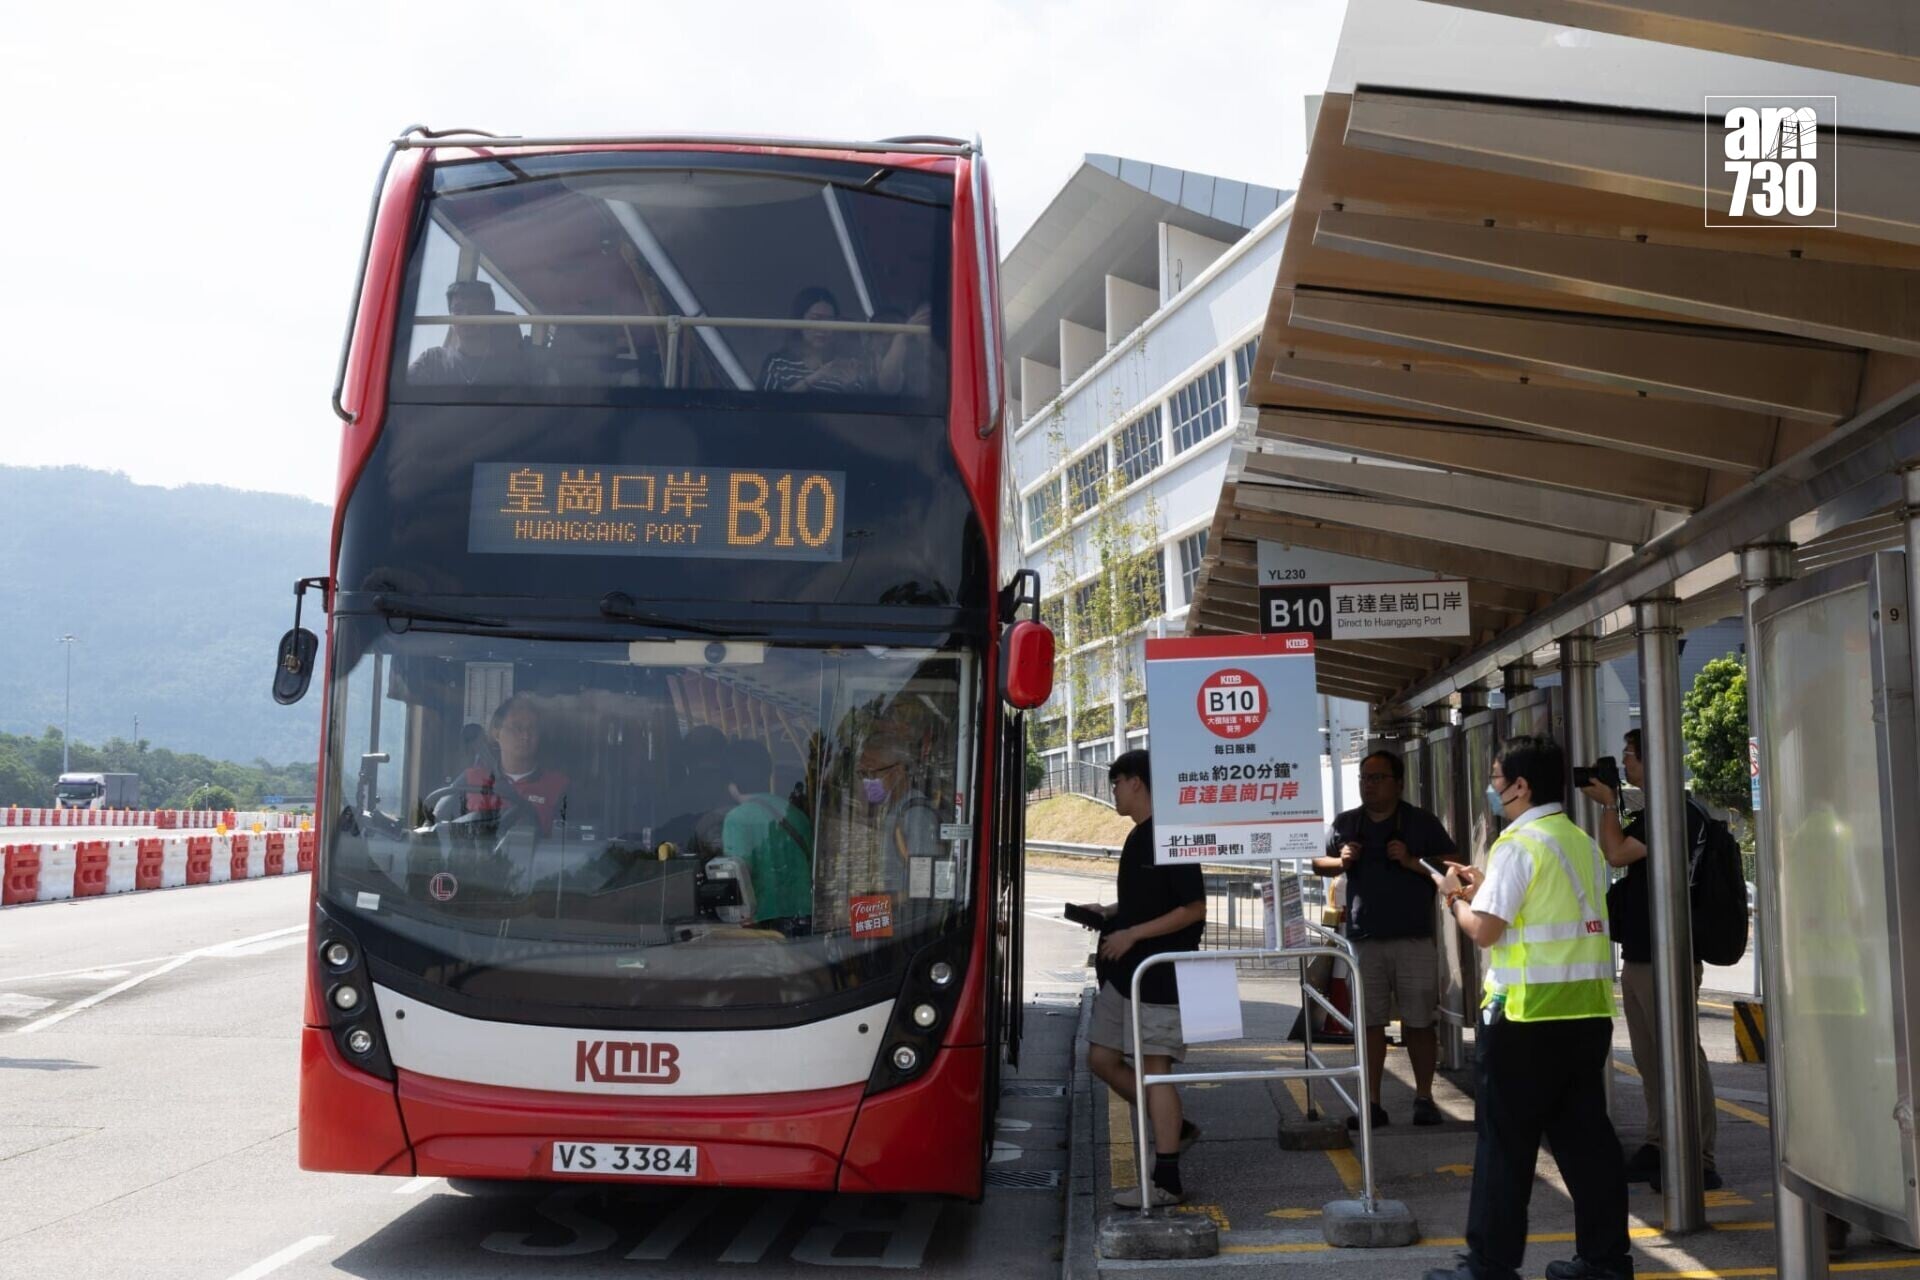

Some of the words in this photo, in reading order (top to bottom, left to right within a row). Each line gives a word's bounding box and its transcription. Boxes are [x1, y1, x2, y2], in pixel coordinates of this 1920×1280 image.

[500, 468, 708, 517] 皇崗口岸
[727, 472, 835, 547] B10
[514, 520, 637, 542] HUANGGANG
[645, 523, 701, 544] PORT
[1268, 569, 1306, 580] YL230
[1270, 598, 1324, 627] B10
[1336, 591, 1462, 614] 直達皇崗口岸
[1889, 607, 1899, 621] 9
[1338, 618, 1361, 628] Direct
[1364, 618, 1373, 627] to
[1374, 617, 1422, 629] Huanggang
[1424, 616, 1442, 626] Port
[1286, 638, 1309, 649] KMB
[1210, 690, 1254, 712] B10
[1214, 743, 1256, 755] 每日服務
[1178, 782, 1299, 805] 直達皇崗口岸
[851, 900, 889, 917] Tourist
[576, 1041, 680, 1084] KMB
[559, 1145, 597, 1169] VS
[612, 1147, 692, 1172] 3384
